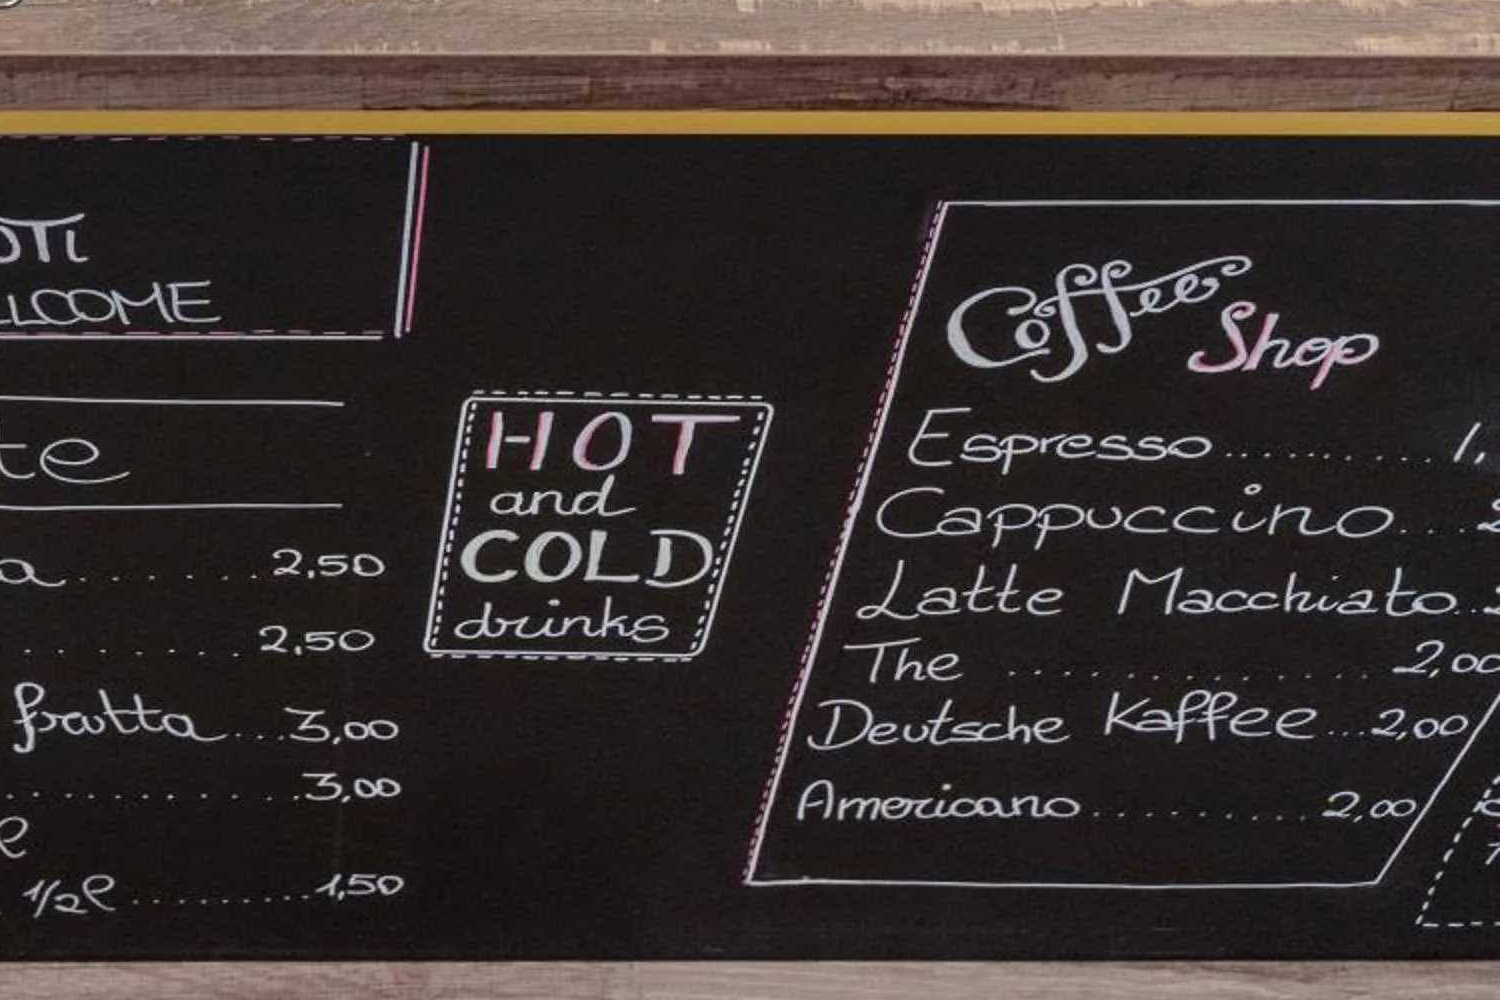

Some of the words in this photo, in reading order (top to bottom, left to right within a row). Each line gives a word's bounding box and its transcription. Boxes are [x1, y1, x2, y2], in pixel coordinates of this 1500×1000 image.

[946, 254, 1253, 383] Coffee
[1186, 301, 1380, 391] Shop
[485, 410, 742, 476] HOT
[907, 407, 1213, 476] Espresso
[489, 473, 637, 518] and
[875, 485, 1395, 551] Cappuccino
[271, 548, 386, 580] 2,50
[459, 528, 714, 588] COLD
[855, 559, 1065, 620] Latte
[1117, 566, 1458, 617] Macchiato
[258, 624, 376, 657] 2,50
[453, 595, 670, 643] drinks
[842, 636, 965, 684] The
[1391, 639, 1500, 679] 2,00
[12, 681, 229, 755] frutta
[283, 706, 400, 746] 3,00
[805, 698, 1072, 752] Deutsche
[1102, 689, 1318, 744] Kaffee
[1370, 708, 1470, 741] 2,00
[301, 772, 402, 804] 3,00
[795, 778, 1082, 821] Americano
[1321, 791, 1418, 823] 2,00
[314, 873, 406, 902] 1,50
